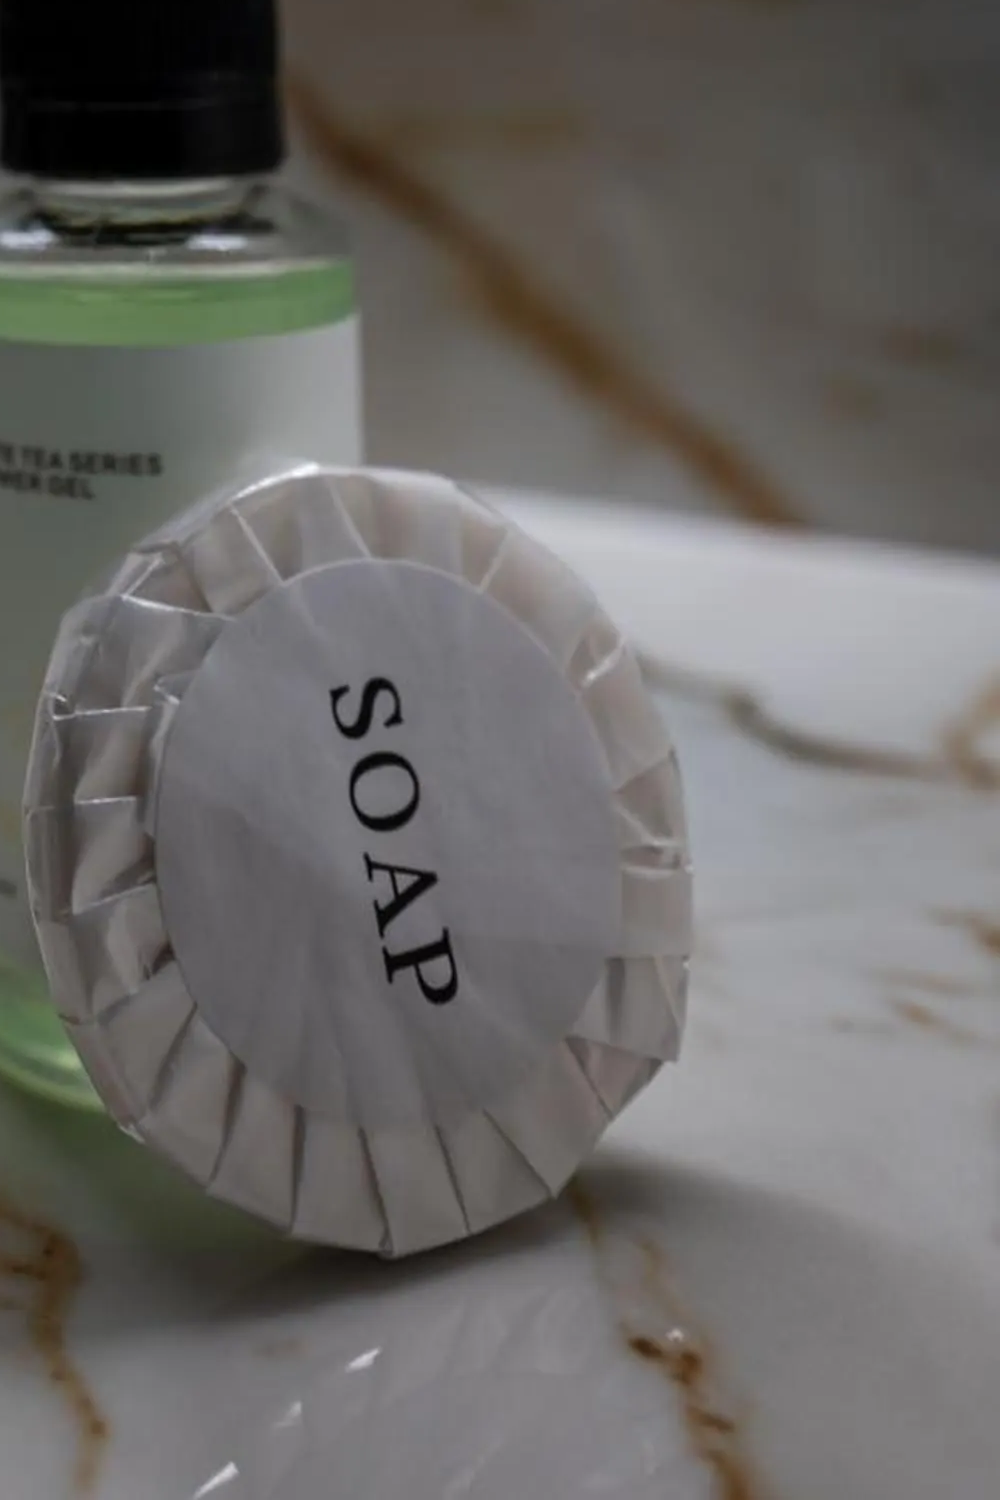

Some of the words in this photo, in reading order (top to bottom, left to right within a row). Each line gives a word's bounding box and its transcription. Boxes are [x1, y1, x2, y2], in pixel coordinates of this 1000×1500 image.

[21, 445, 64, 471] TEA
[70, 450, 164, 477] SERIES
[48, 475, 97, 500] GEL
[329, 676, 459, 1006] SOAP
